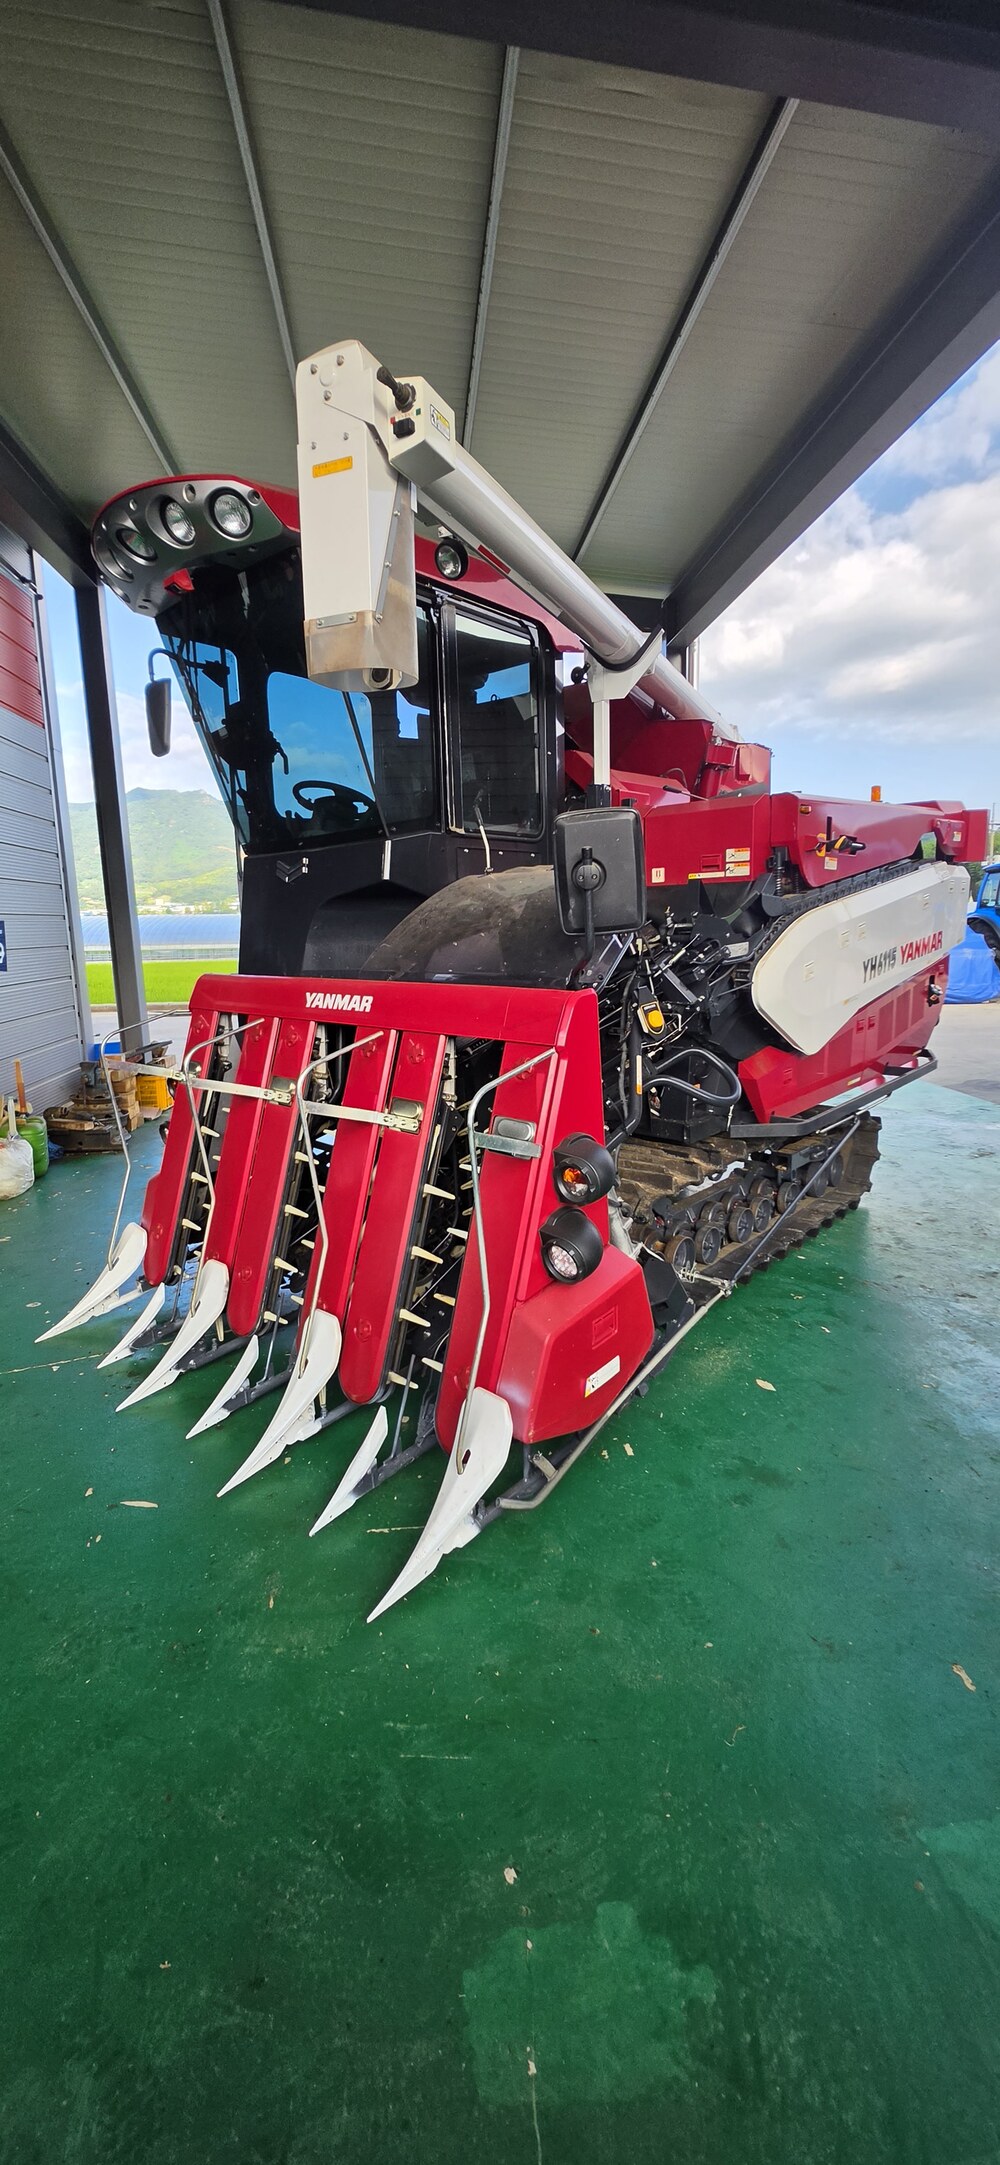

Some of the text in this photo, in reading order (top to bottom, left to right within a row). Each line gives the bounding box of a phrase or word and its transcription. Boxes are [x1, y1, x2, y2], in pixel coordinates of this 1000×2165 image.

[862, 930, 943, 984] YH6115 YANMAR
[305, 992, 374, 1013] YANMAR
